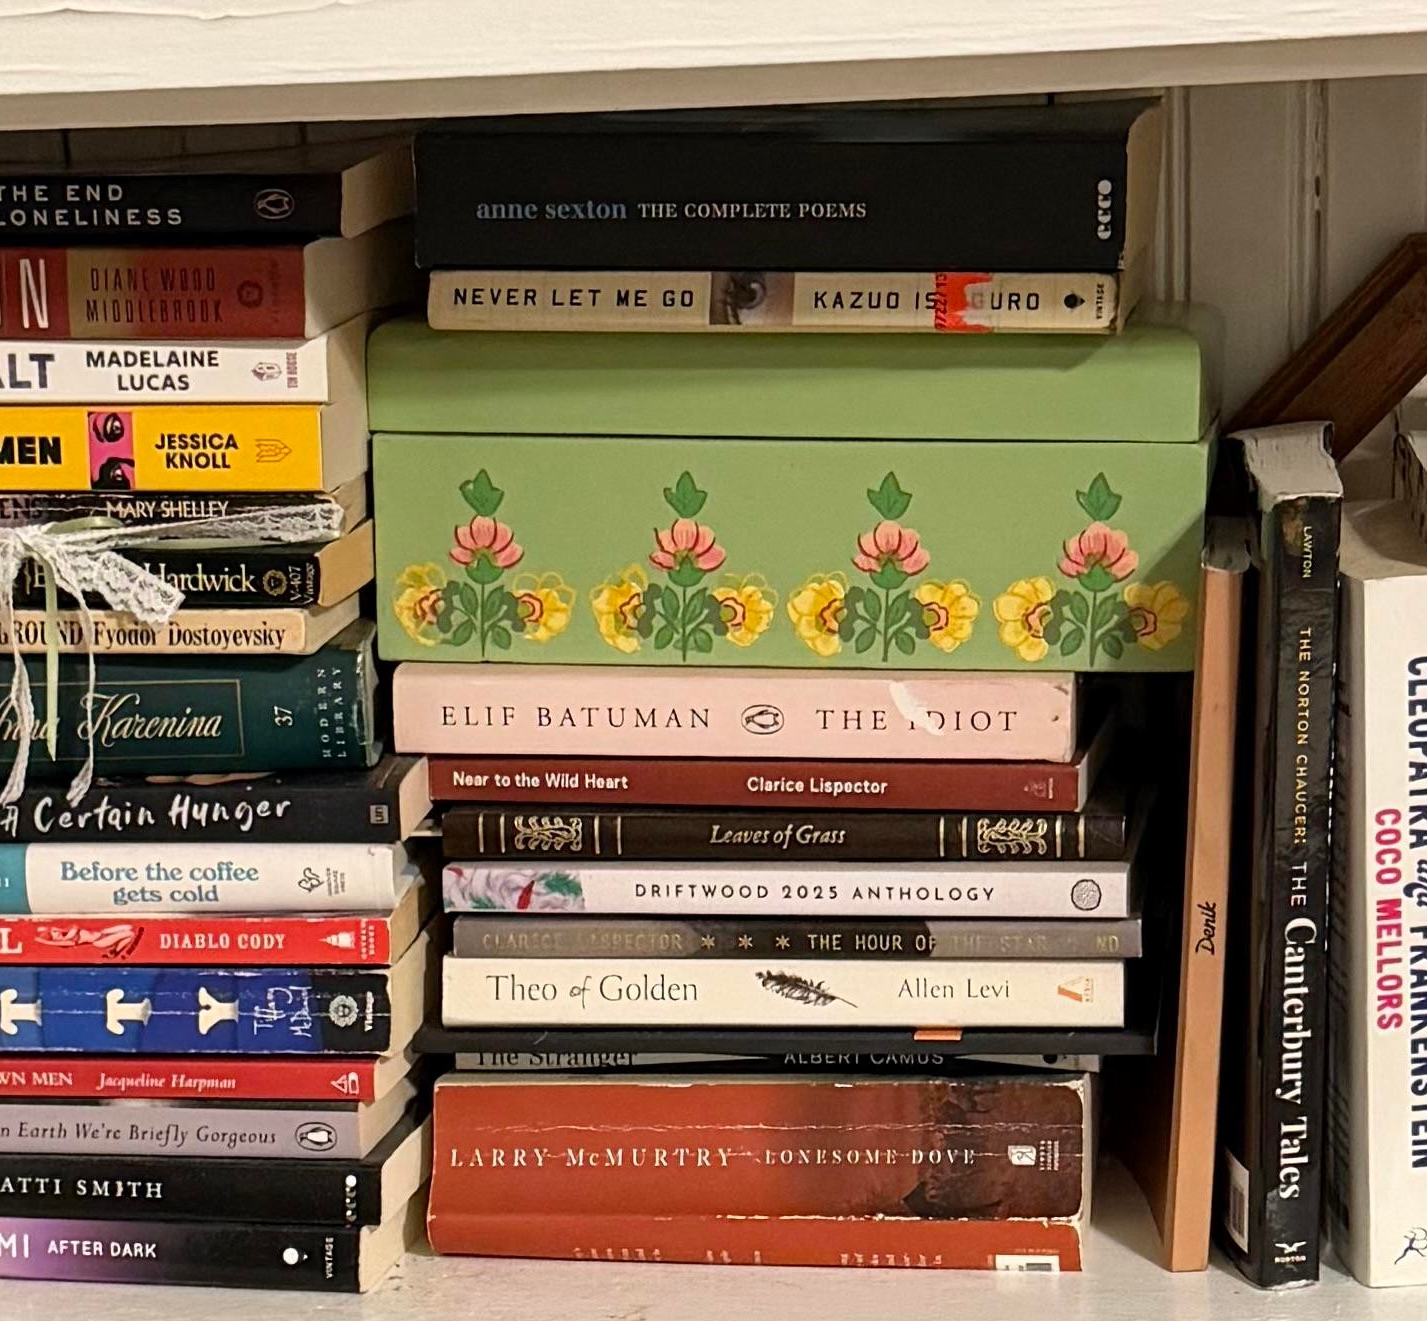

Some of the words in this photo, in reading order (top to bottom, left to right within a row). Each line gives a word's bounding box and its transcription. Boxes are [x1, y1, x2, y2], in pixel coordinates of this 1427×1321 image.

[453, 287, 537, 306] NEVER
[86, 350, 220, 369] MADELAINE
[117, 374, 191, 392] LUCAS
[1302, 526, 1313, 578] LAWTON
[167, 621, 286, 650] Dostoyevsky
[441, 706, 517, 728] ELIF
[537, 706, 710, 730] BATUMAN
[1297, 671, 1310, 745] NORTON
[545, 772, 578, 790] Wild
[583, 773, 628, 791] Heart
[746, 777, 805, 795] Clarice
[810, 778, 887, 798] Lispector
[1293, 754, 1308, 845] CHAUCER:
[1375, 809, 1402, 884] COCO
[59, 861, 140, 884] Before
[189, 861, 259, 882] coffee
[635, 883, 769, 900] DRIFTWOOD
[782, 885, 840, 901] 2025
[852, 885, 996, 903] ANTHOLOGY
[159, 932, 230, 950] DIABLO
[237, 932, 287, 950] CODY
[1376, 899, 1404, 1031] MELLORS
[486, 974, 556, 1003] Theo
[599, 976, 699, 1004] Golden
[897, 977, 954, 999] Allen
[966, 978, 1010, 1000] Levi
[1273, 918, 1317, 1101] Canterbury
[97, 1072, 167, 1092] Jacqueline
[1278, 1115, 1308, 1200] Tales
